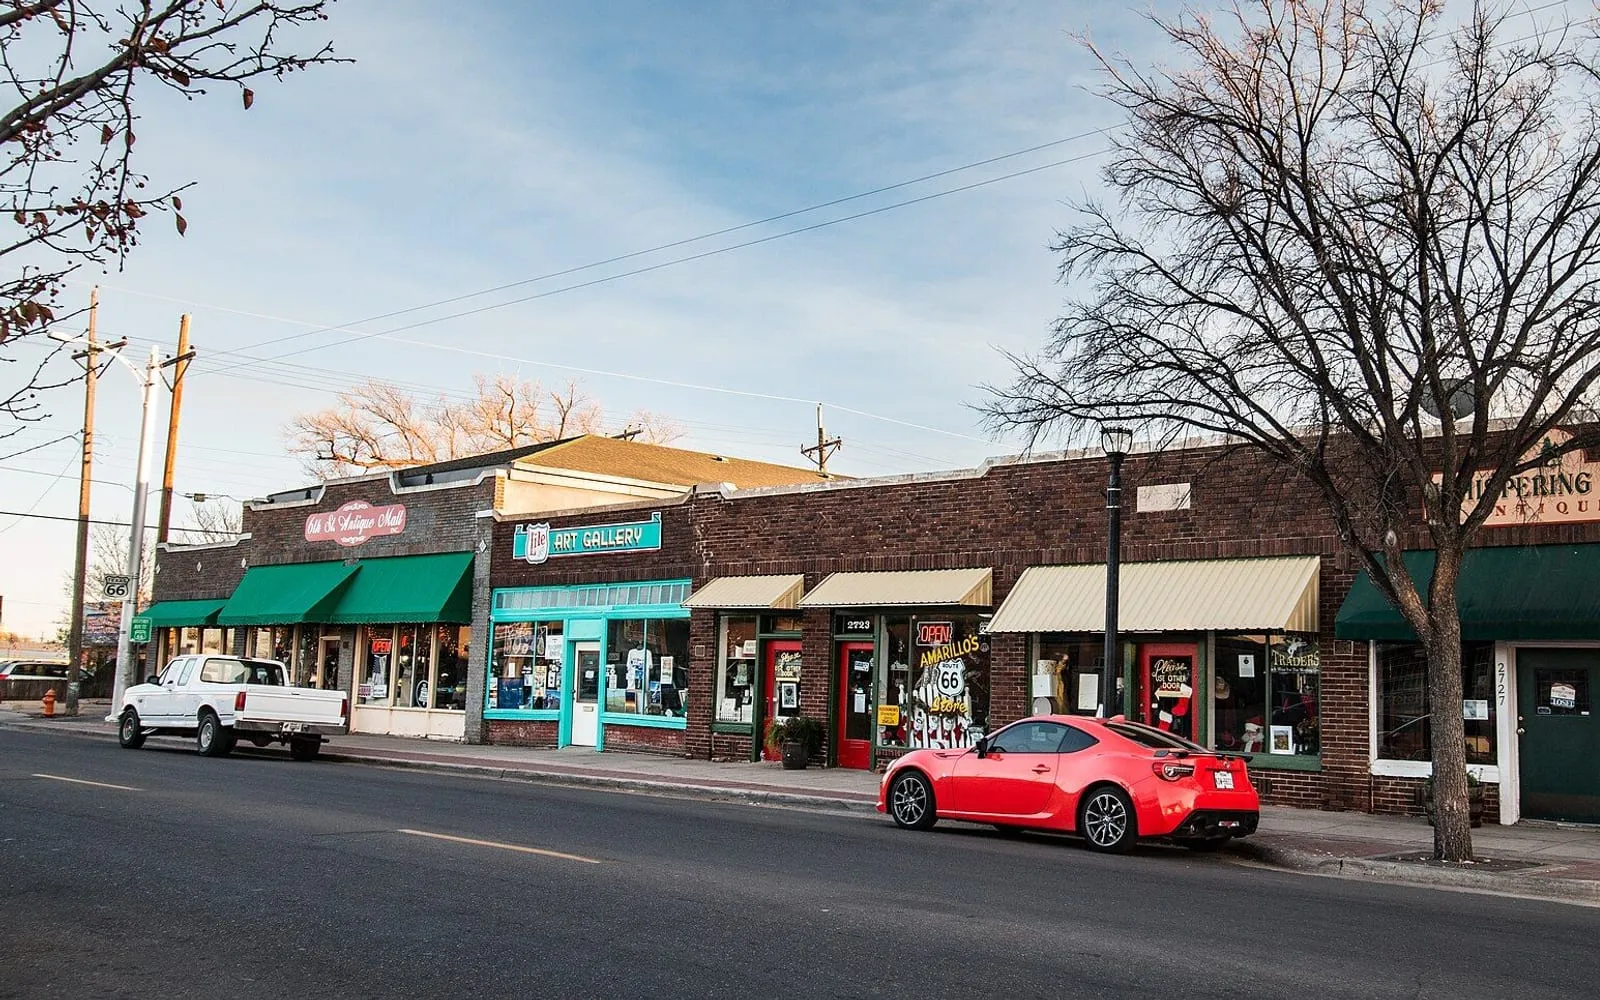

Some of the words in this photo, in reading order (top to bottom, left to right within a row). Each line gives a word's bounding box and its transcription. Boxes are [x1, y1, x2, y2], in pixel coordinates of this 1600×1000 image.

[1494, 500, 1600, 517] NTIQU
[338, 513, 375, 535] Antique
[377, 507, 404, 528] Mall
[554, 532, 578, 550] ART
[582, 527, 643, 549] GALLERY
[106, 584, 126, 596] 66
[847, 620, 871, 630] 2723
[920, 626, 950, 643] OPEN
[919, 634, 980, 668] AMARILLO'S
[1271, 649, 1320, 667] TRADERS
[942, 662, 960, 670] ROUTE
[1152, 659, 1188, 682] Please
[941, 671, 960, 690] 66
[1497, 662, 1506, 706] 2727
[929, 696, 968, 713] Store
